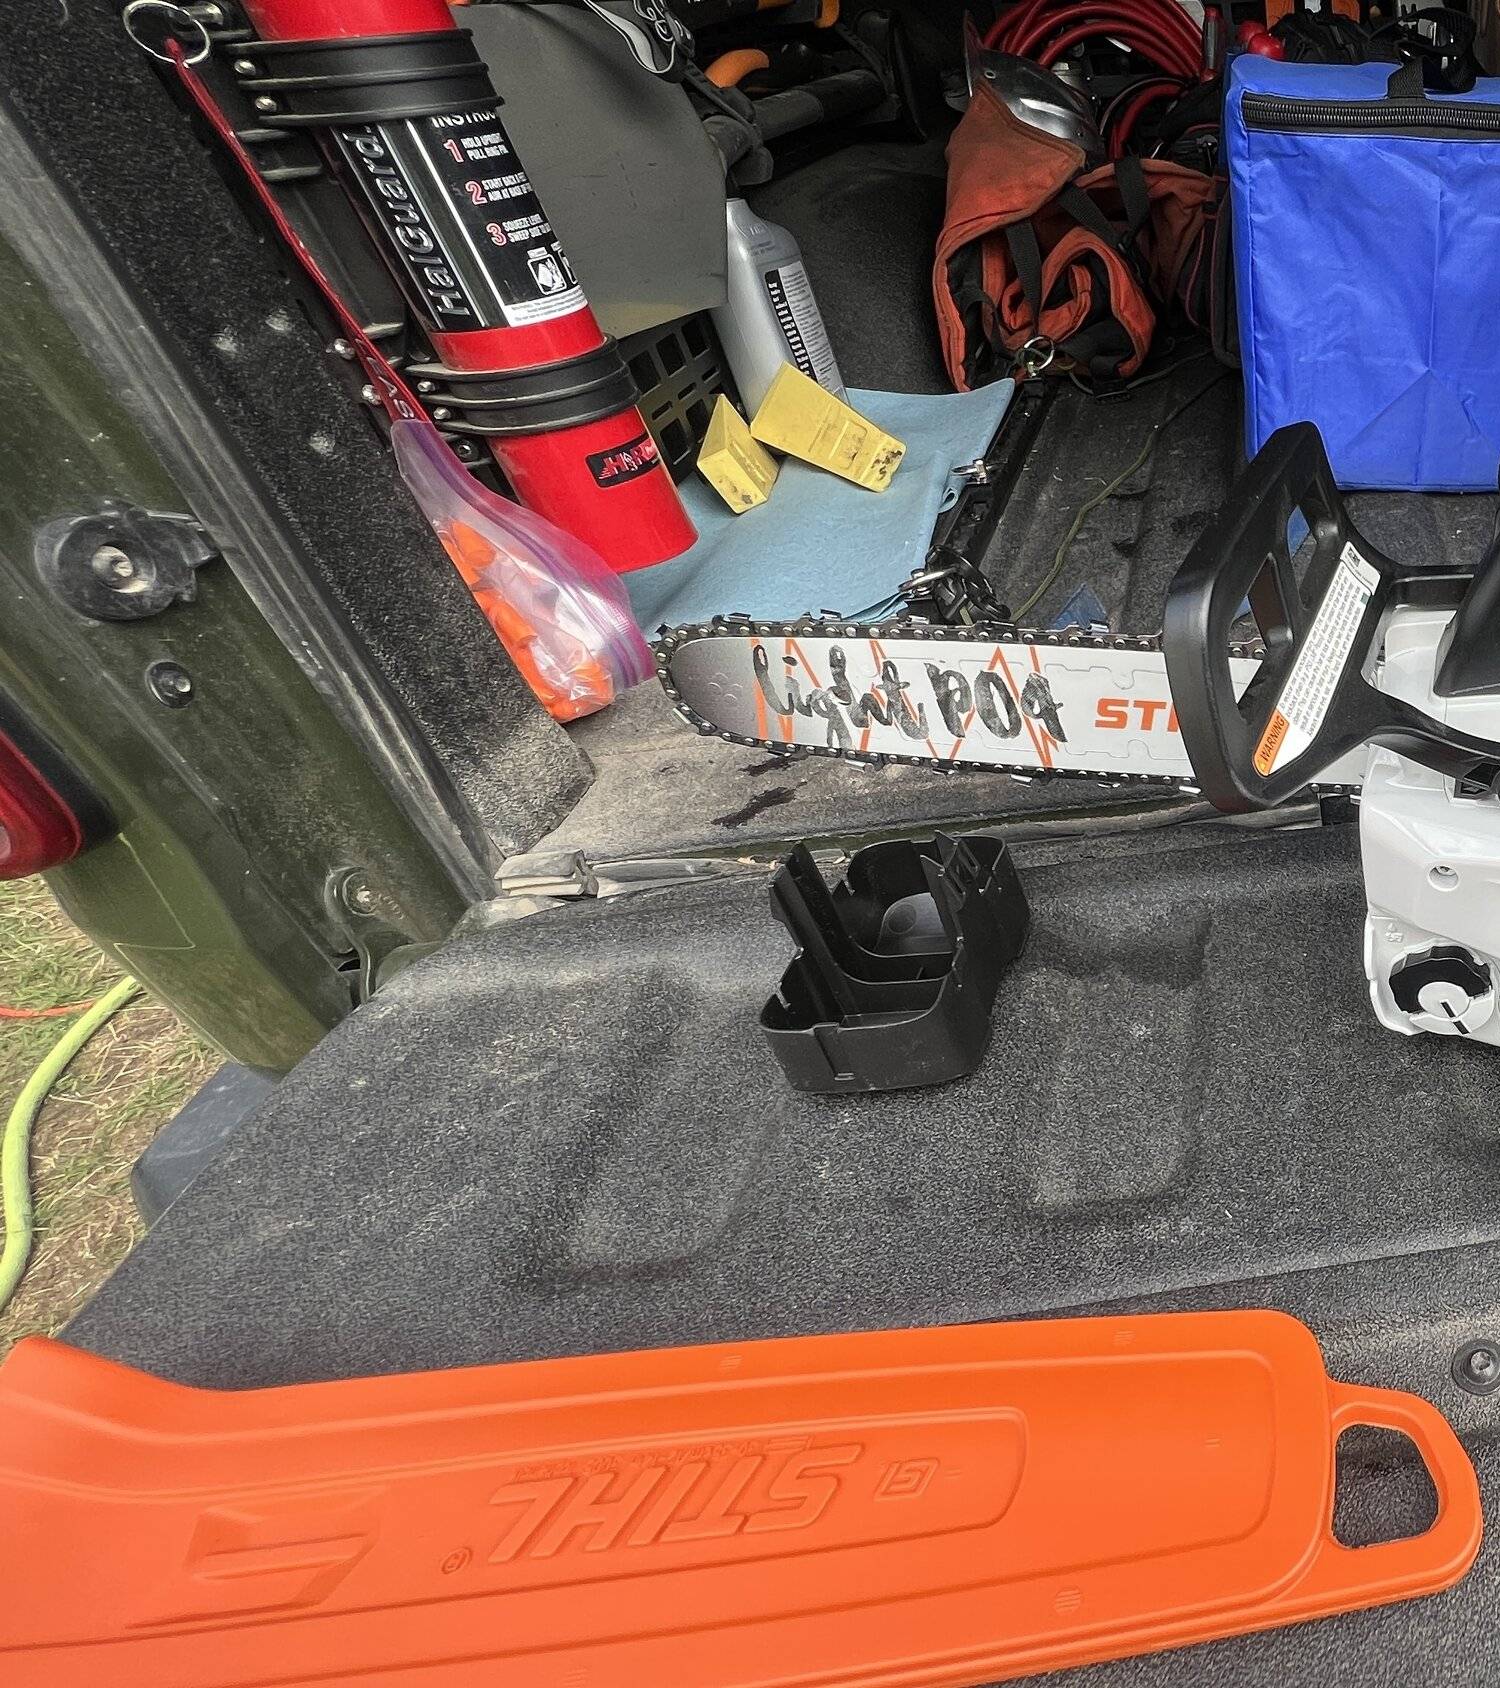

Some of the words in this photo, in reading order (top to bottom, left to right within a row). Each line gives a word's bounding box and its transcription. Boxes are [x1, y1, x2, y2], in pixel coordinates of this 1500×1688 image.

[443, 139, 464, 163] 1
[465, 180, 488, 205] 2
[486, 223, 507, 246] 3
[1095, 698, 1179, 732] STI
[1260, 715, 1285, 762] WARNING
[488, 1441, 866, 1564] STIHL
